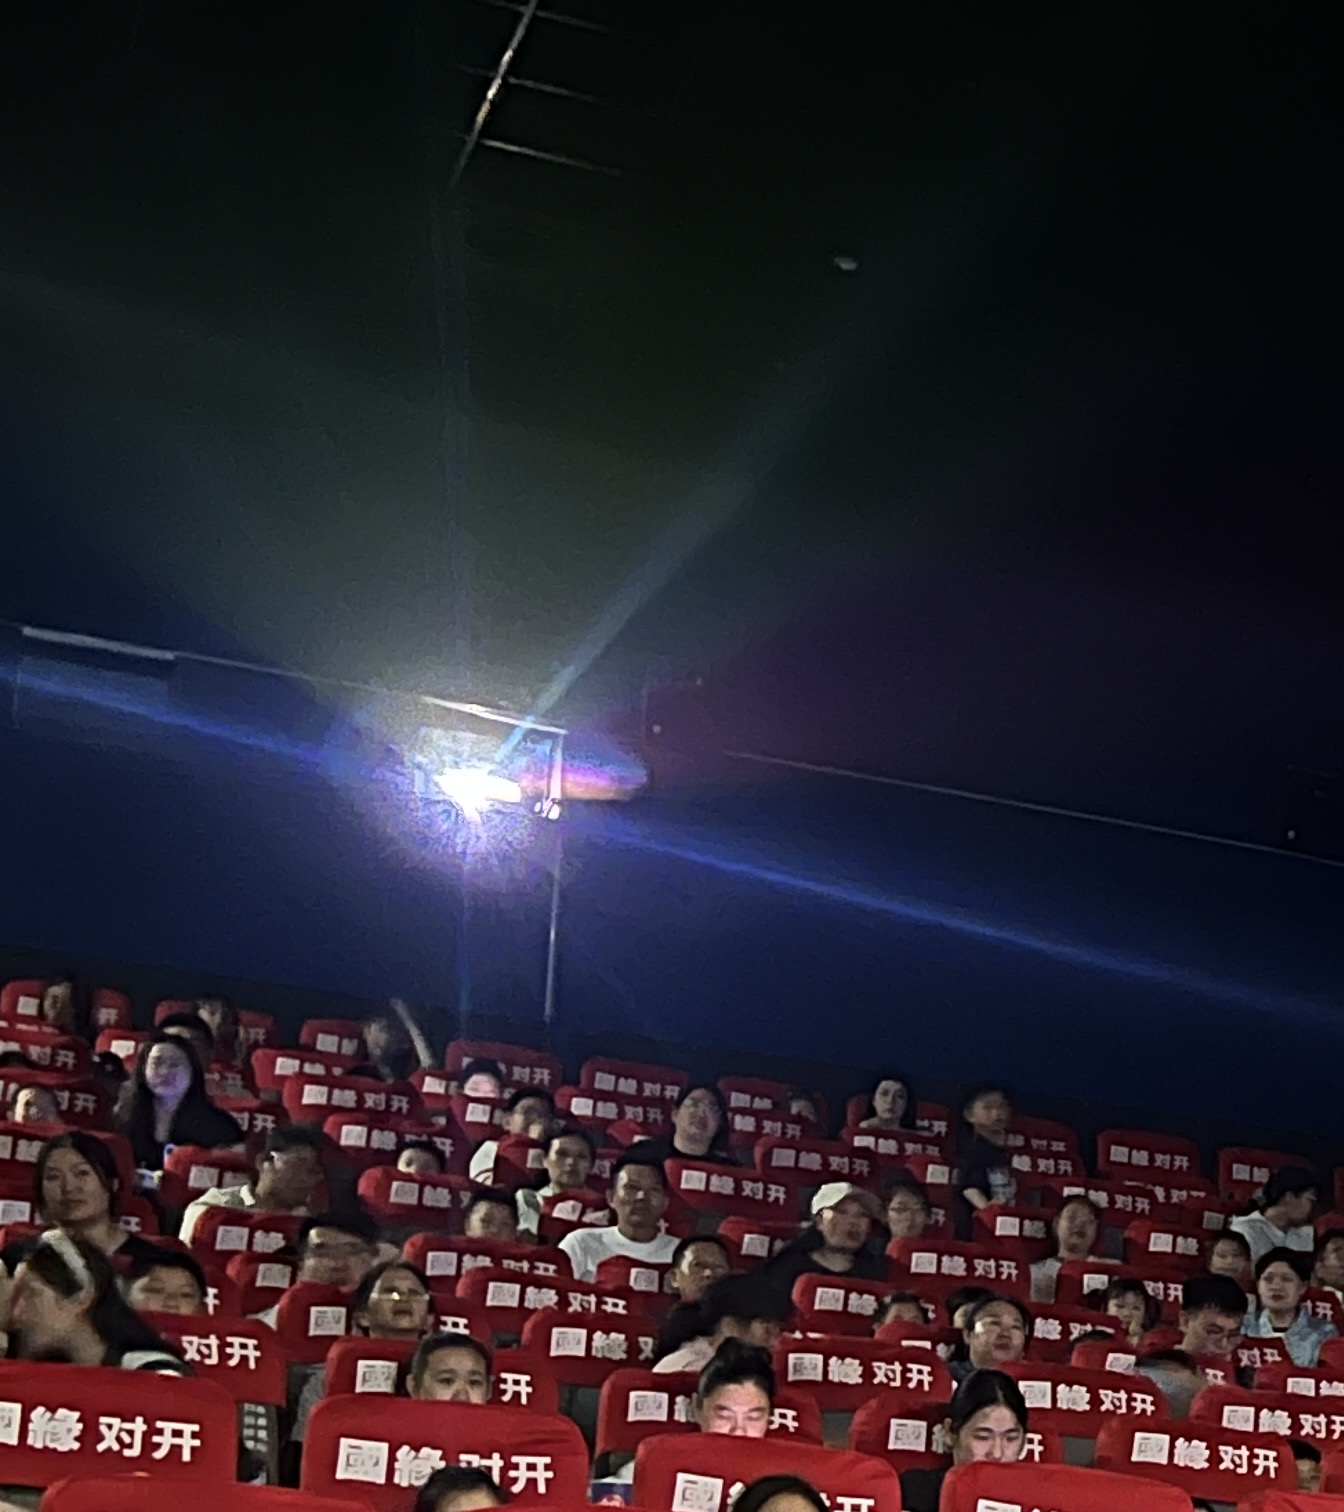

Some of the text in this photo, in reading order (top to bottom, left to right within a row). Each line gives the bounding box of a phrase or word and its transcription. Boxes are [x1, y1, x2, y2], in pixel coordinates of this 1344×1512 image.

[181, 1335, 261, 1369] 对开
[872, 1361, 933, 1391] 对开
[1099, 1389, 1155, 1415] 对开
[97, 1416, 200, 1461] 对开
[1219, 1446, 1278, 1478] 对开
